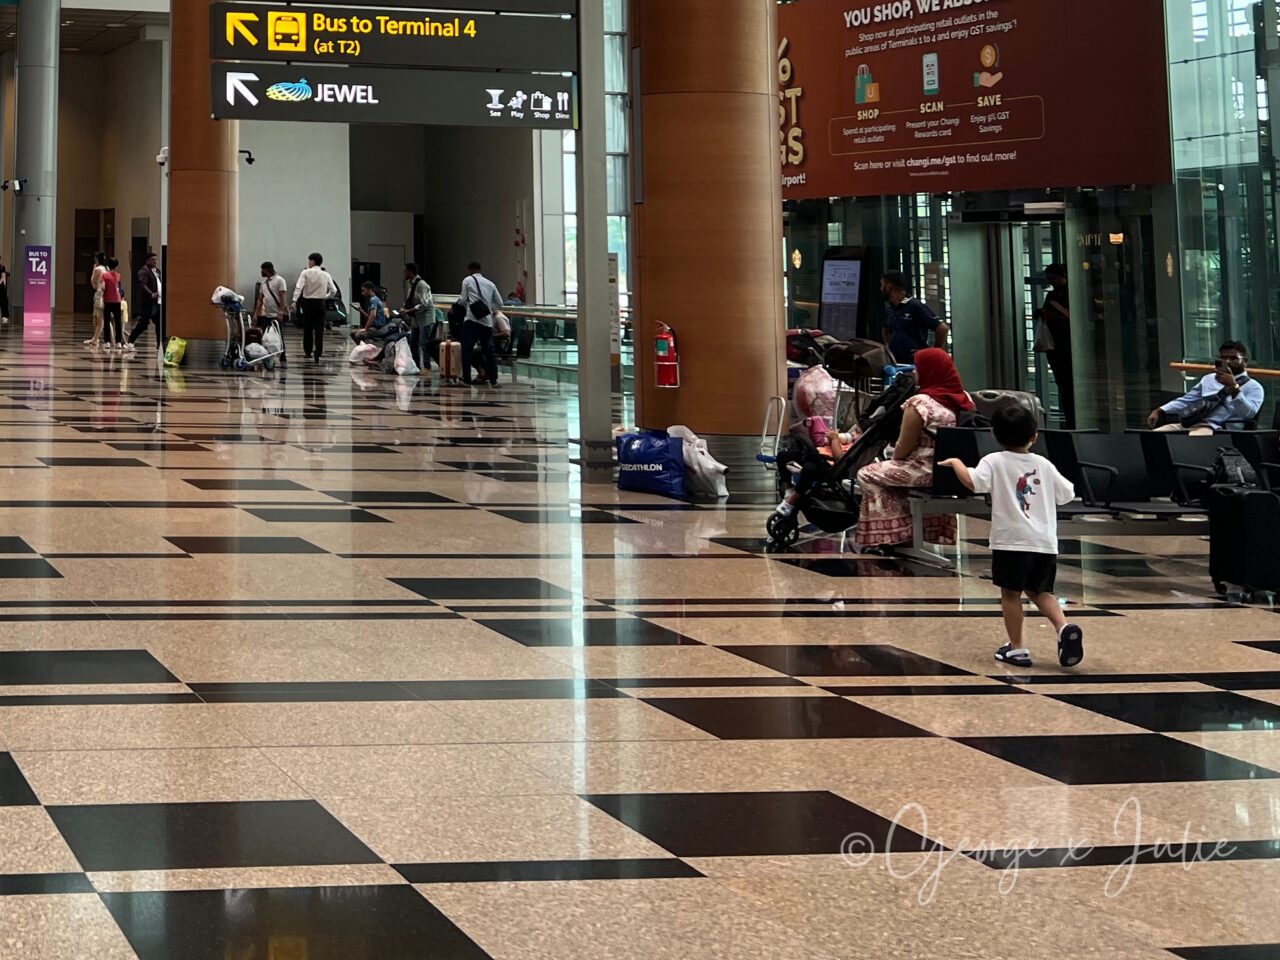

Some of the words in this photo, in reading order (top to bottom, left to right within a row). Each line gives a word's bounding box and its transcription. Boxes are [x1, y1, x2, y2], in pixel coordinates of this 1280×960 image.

[844, 6, 871, 28] YOU
[873, 0, 913, 23] SHOP,
[313, 13, 346, 33] Bus
[350, 14, 373, 34] to
[376, 15, 459, 37] Terminal
[463, 19, 477, 38] 4
[858, 32, 874, 43] Shop
[874, 30, 889, 40] now
[889, 28, 895, 38] at
[895, 21, 935, 37] participating
[935, 17, 953, 29] retail
[953, 14, 978, 25] outlets
[978, 11, 985, 20] in
[986, 9, 998, 19] the
[313, 39, 335, 56] (at
[337, 40, 361, 57] T2)
[845, 44, 863, 58] public
[863, 44, 880, 54] areas
[880, 41, 888, 50] of
[888, 37, 918, 50] Terminals
[923, 34, 931, 44] to
[936, 30, 950, 41] and
[950, 27, 969, 39] enjoy
[969, 25, 985, 36] GST
[314, 83, 379, 104] JEWEL
[977, 94, 1002, 107] SAVE
[919, 101, 944, 114] SCAN
[510, 111, 524, 119] Play
[534, 111, 550, 119] Shop
[857, 108, 880, 121] SHOP
[970, 113, 986, 124] Enjoy
[997, 111, 1010, 120] GST
[906, 120, 926, 129] Present
[927, 120, 939, 128] your
[940, 117, 960, 127] Changi
[978, 124, 1002, 134] Savings
[914, 130, 938, 139] Rewards
[938, 128, 952, 137] card
[853, 161, 869, 171] Scan
[869, 160, 884, 170] here
[892, 158, 906, 168] visit
[906, 155, 957, 167] changi.me/gst
[957, 154, 965, 163] to
[966, 153, 980, 163] find
[980, 152, 994, 162] out
[994, 150, 1017, 161] more!
[28, 257, 48, 275] T4
[620, 463, 663, 472] DECATHLON
